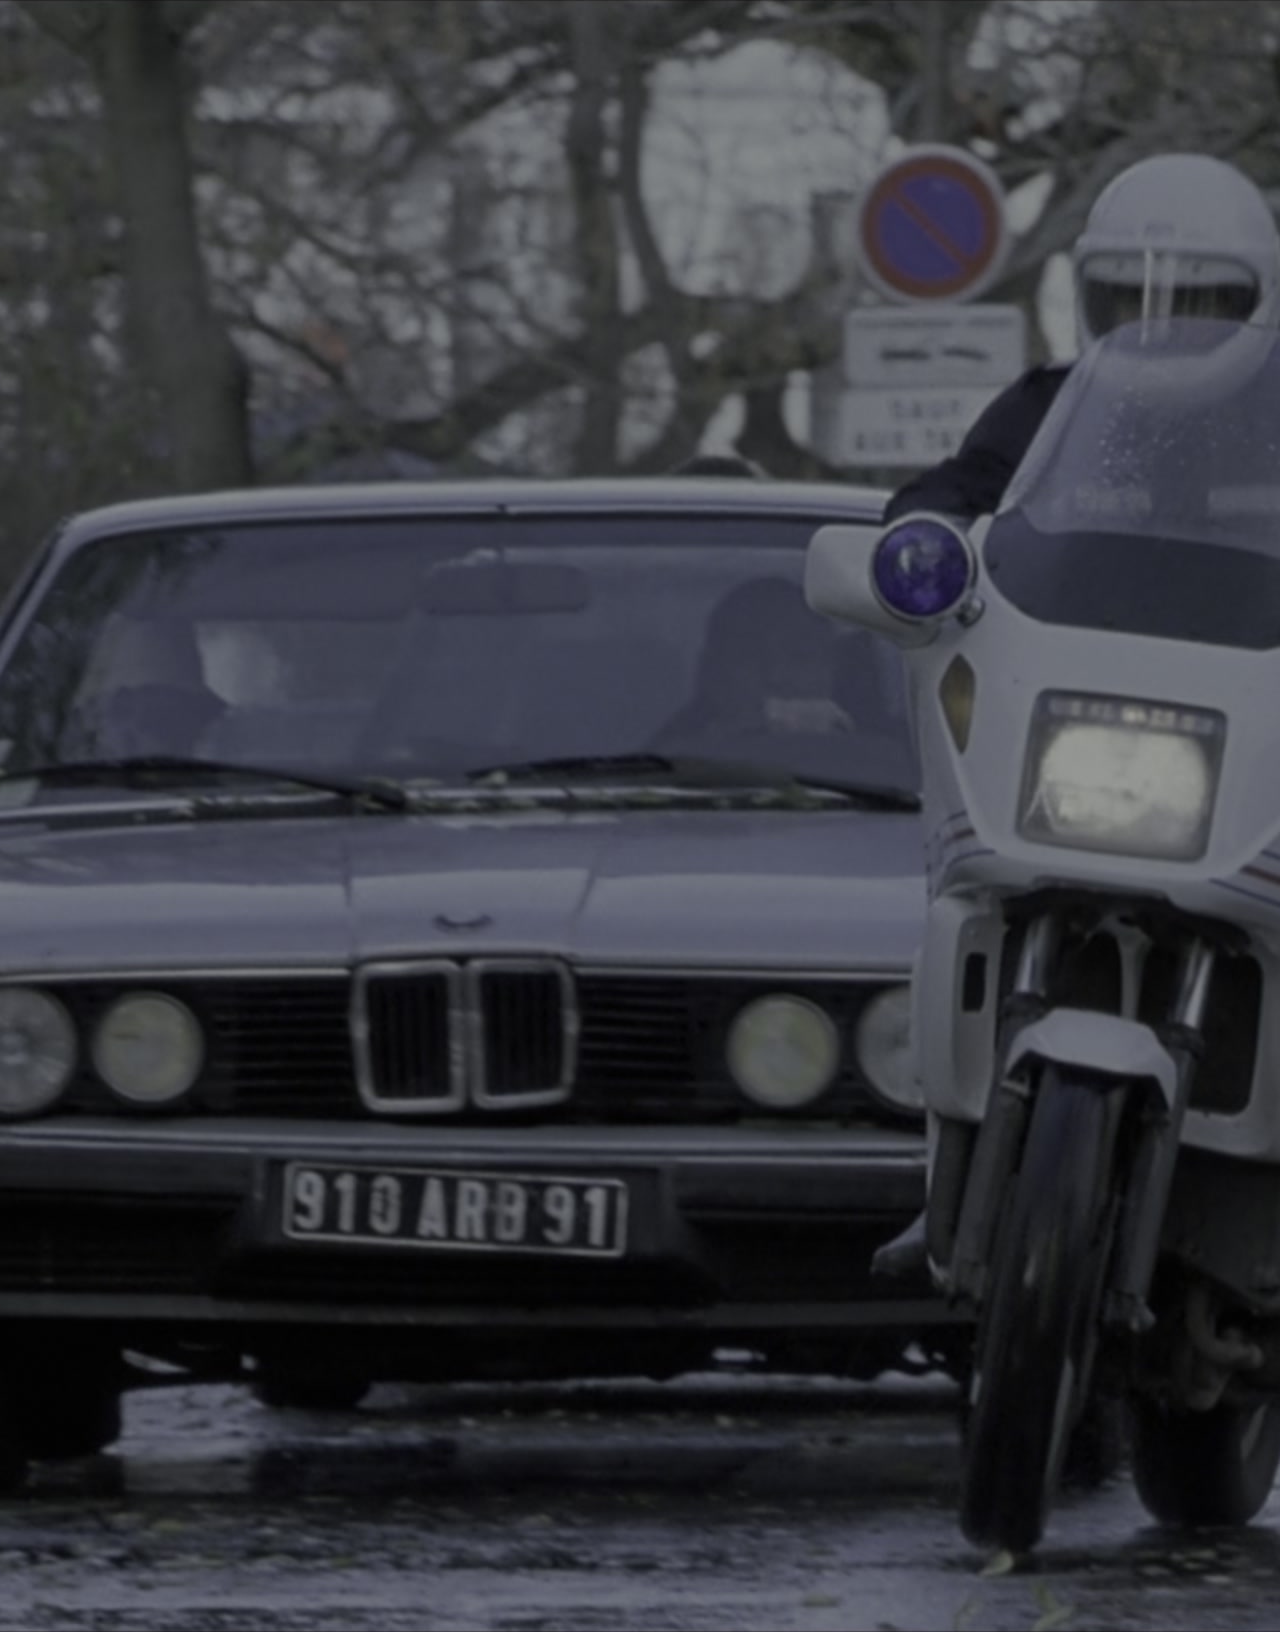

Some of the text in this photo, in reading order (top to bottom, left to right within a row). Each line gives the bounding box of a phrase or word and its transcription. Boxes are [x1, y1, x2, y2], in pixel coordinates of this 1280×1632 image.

[293, 1170, 609, 1247] 910 ARB 91
